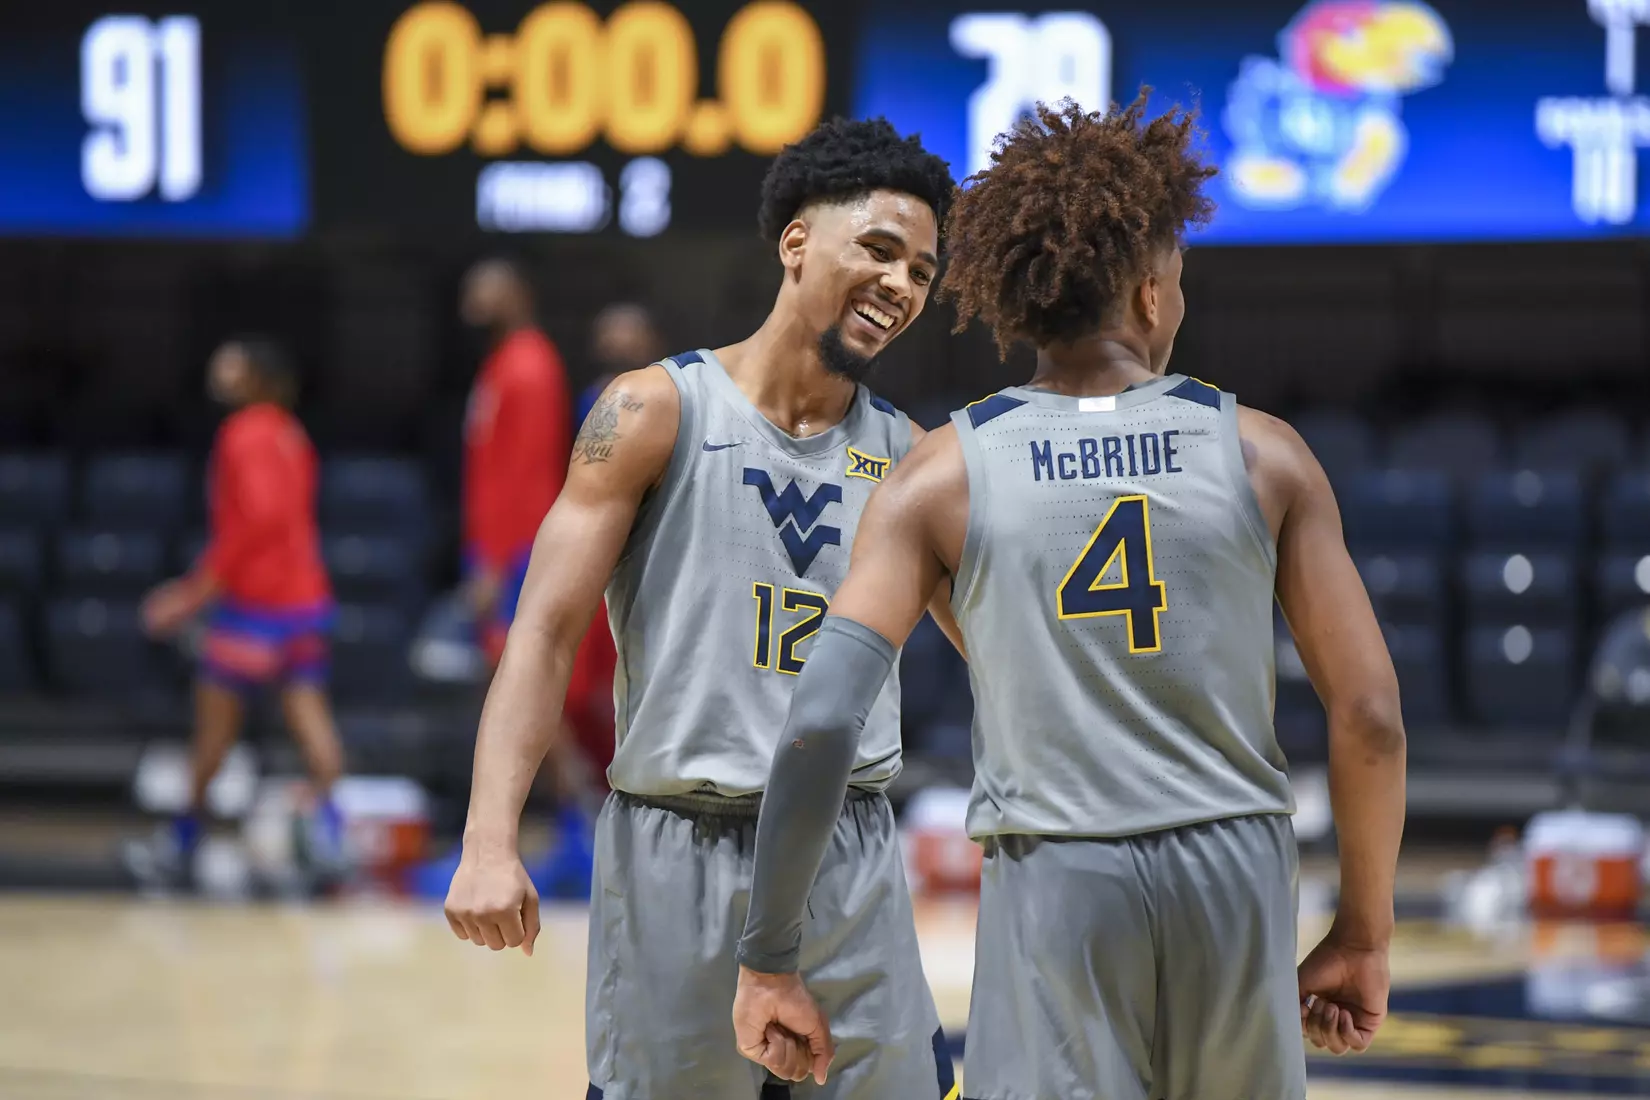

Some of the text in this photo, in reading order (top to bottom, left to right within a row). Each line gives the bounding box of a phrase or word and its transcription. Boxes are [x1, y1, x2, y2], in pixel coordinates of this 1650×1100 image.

[80, 14, 202, 200] 91
[382, 0, 826, 156] 0:00.0
[849, 450, 888, 480] XII
[1030, 429, 1183, 481] McBRIDE
[753, 581, 830, 676] 12
[1056, 494, 1168, 654] 4
